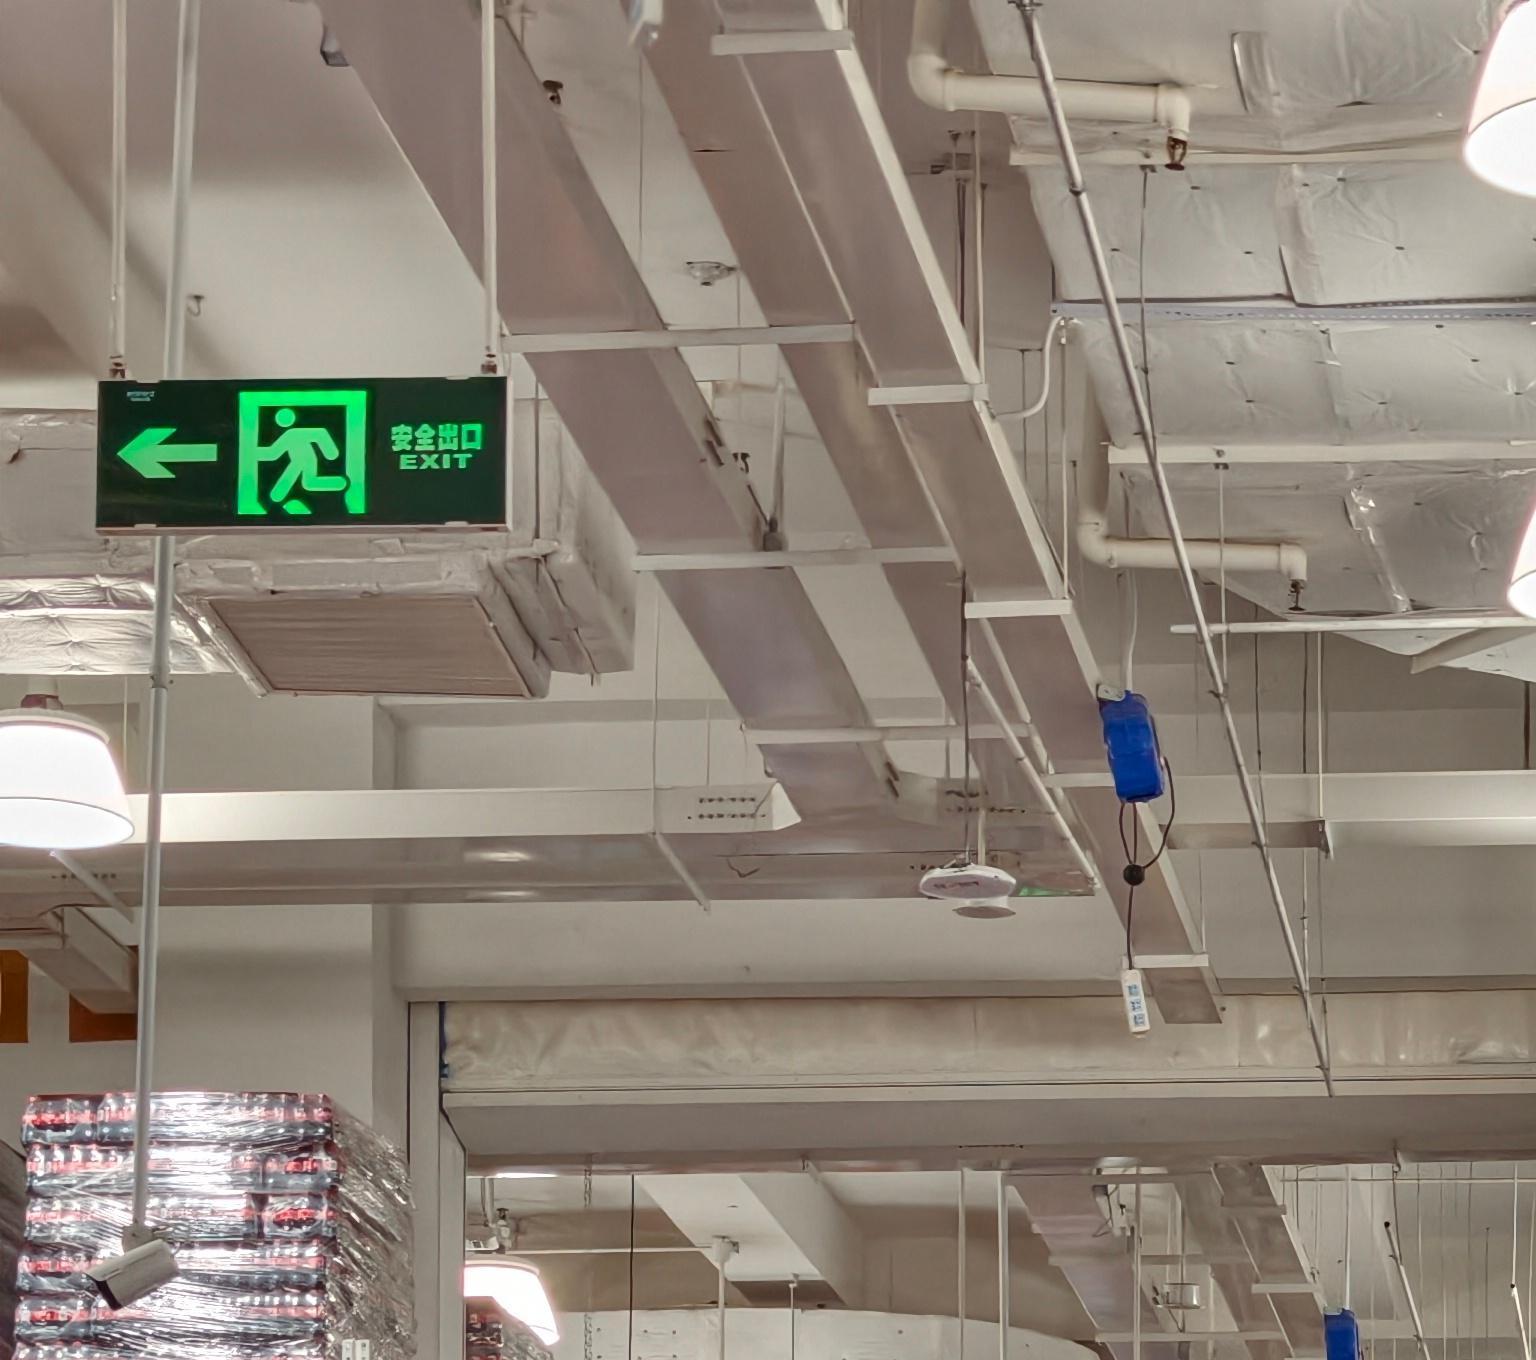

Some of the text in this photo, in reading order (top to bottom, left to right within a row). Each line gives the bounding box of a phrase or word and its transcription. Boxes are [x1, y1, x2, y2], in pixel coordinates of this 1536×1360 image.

[391, 424, 482, 451] 安全出口
[400, 454, 472, 470] EXIT
